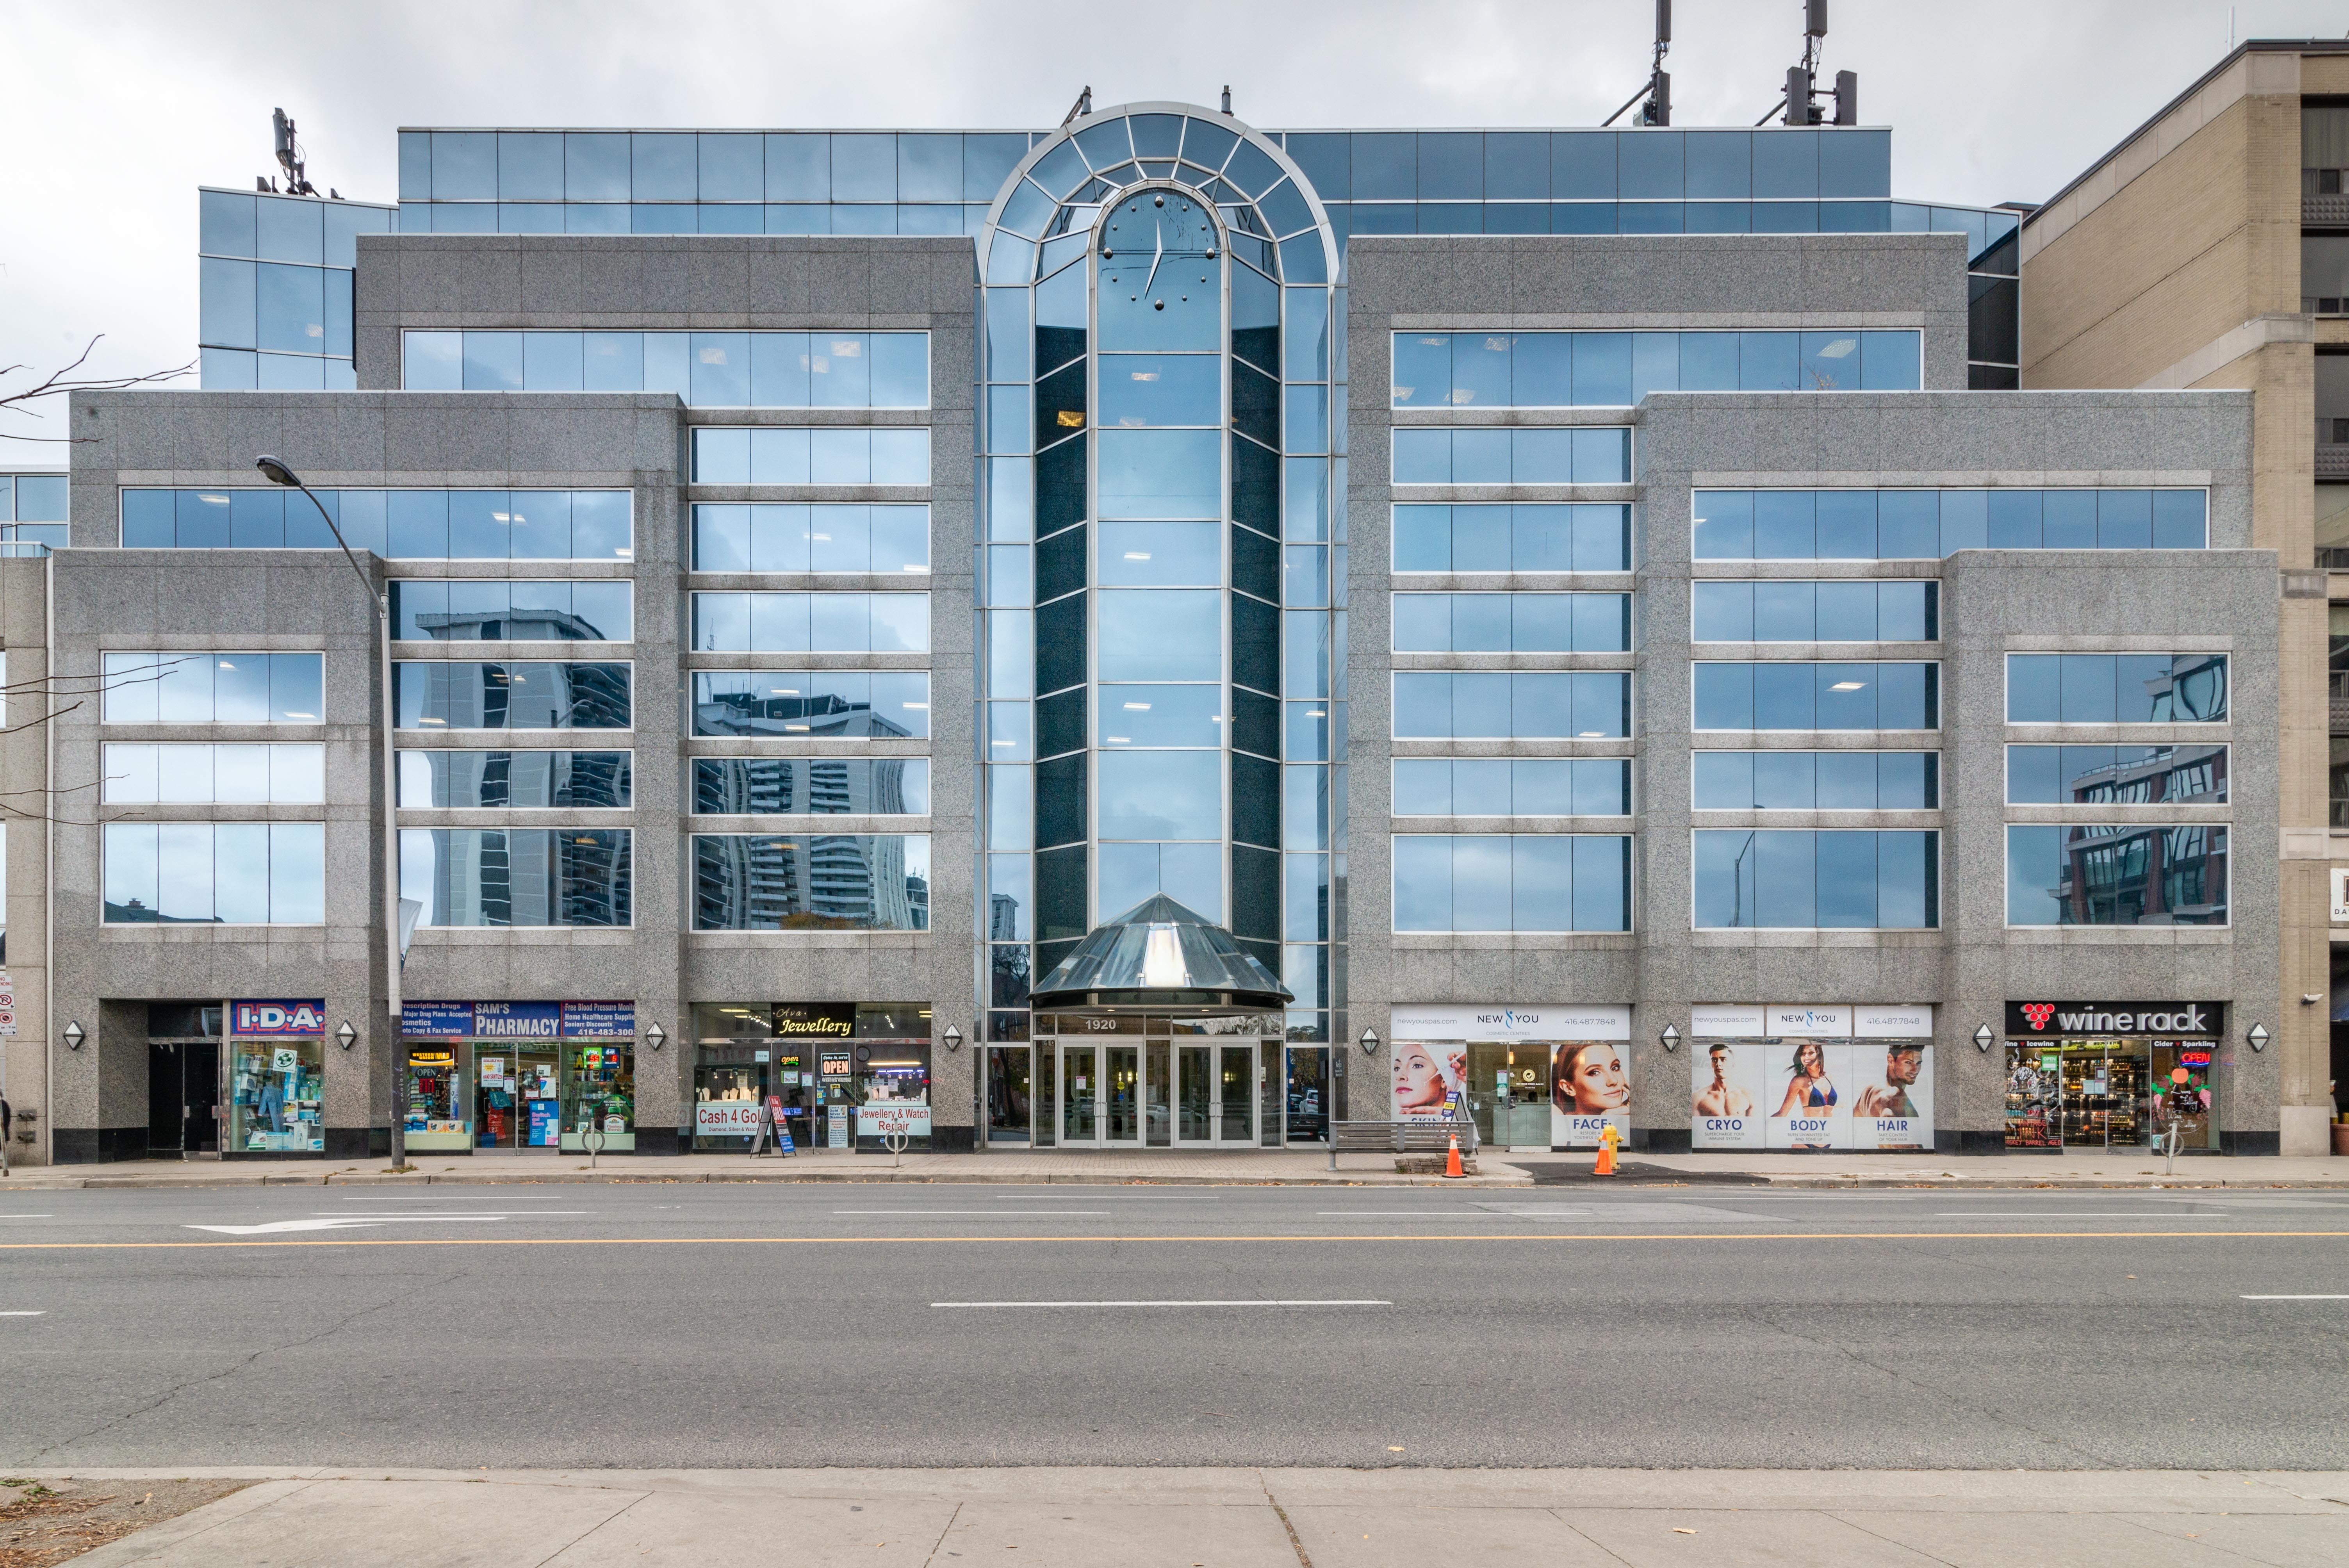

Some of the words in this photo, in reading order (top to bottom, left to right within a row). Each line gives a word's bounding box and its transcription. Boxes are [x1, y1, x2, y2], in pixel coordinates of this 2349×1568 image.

[475, 1003, 509, 1014] SAM'S
[776, 1008, 802, 1017] Ava
[2057, 1006, 2133, 1031] wine
[2137, 1004, 2206, 1031] rack
[476, 1016, 559, 1035] PHARMACY
[779, 1018, 851, 1036] Jewellery
[1085, 1020, 1116, 1030] 1920
[781, 1057, 799, 1065] open
[2182, 1053, 2210, 1062] OPEN
[823, 1061, 848, 1073] OPEN
[699, 1109, 727, 1124] Cash
[731, 1109, 737, 1123] 4
[741, 1109, 761, 1124] Gol
[860, 1108, 895, 1121] Jewellery
[898, 1109, 903, 1118] &
[905, 1109, 929, 1118] Watch
[1574, 1119, 1607, 1129] FACE
[1706, 1119, 1742, 1130] CRYO
[1791, 1120, 1827, 1131] BODY
[1877, 1120, 1908, 1131] HAIR
